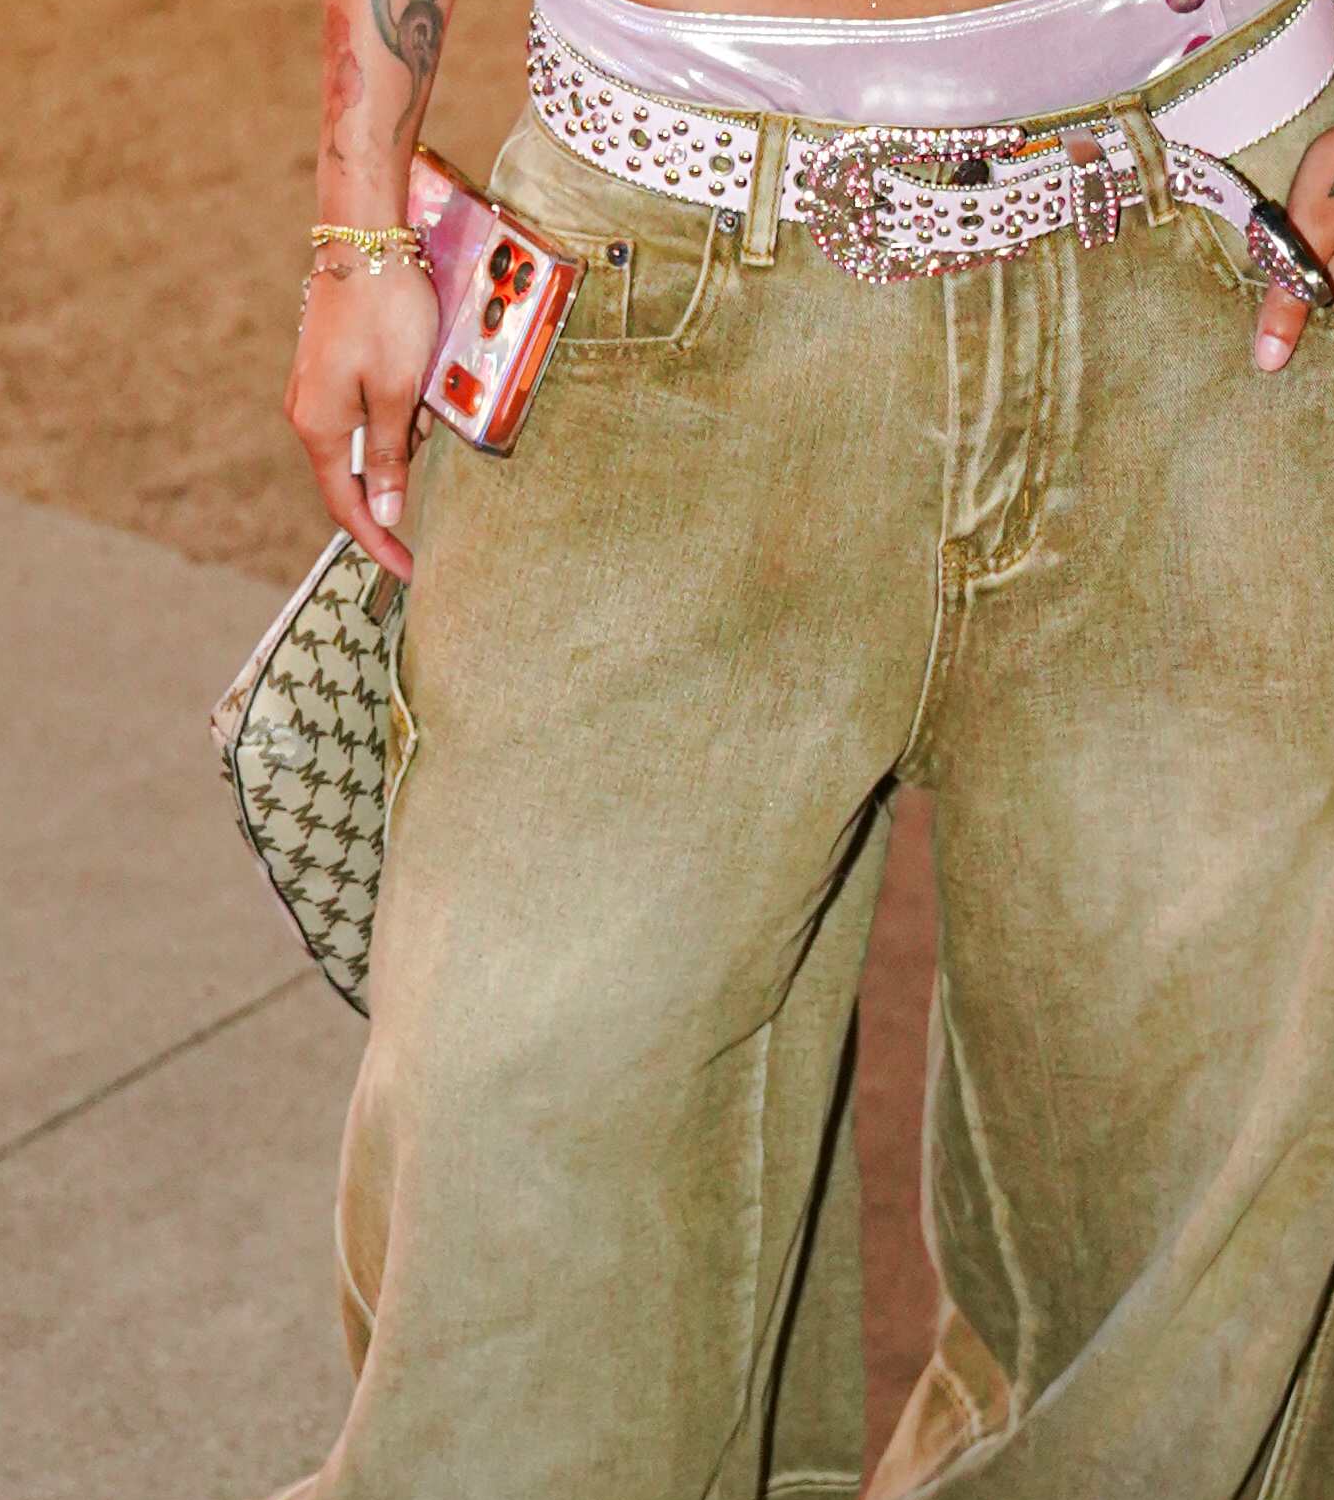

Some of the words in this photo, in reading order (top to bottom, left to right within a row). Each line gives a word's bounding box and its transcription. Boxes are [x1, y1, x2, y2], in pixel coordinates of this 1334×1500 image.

[333, 624, 370, 672] MK
[309, 667, 348, 713] MK
[352, 676, 385, 722] MK
[290, 709, 330, 757] MK
[331, 718, 366, 763] MK
[335, 768, 369, 812] MK
[291, 801, 331, 839] MK
